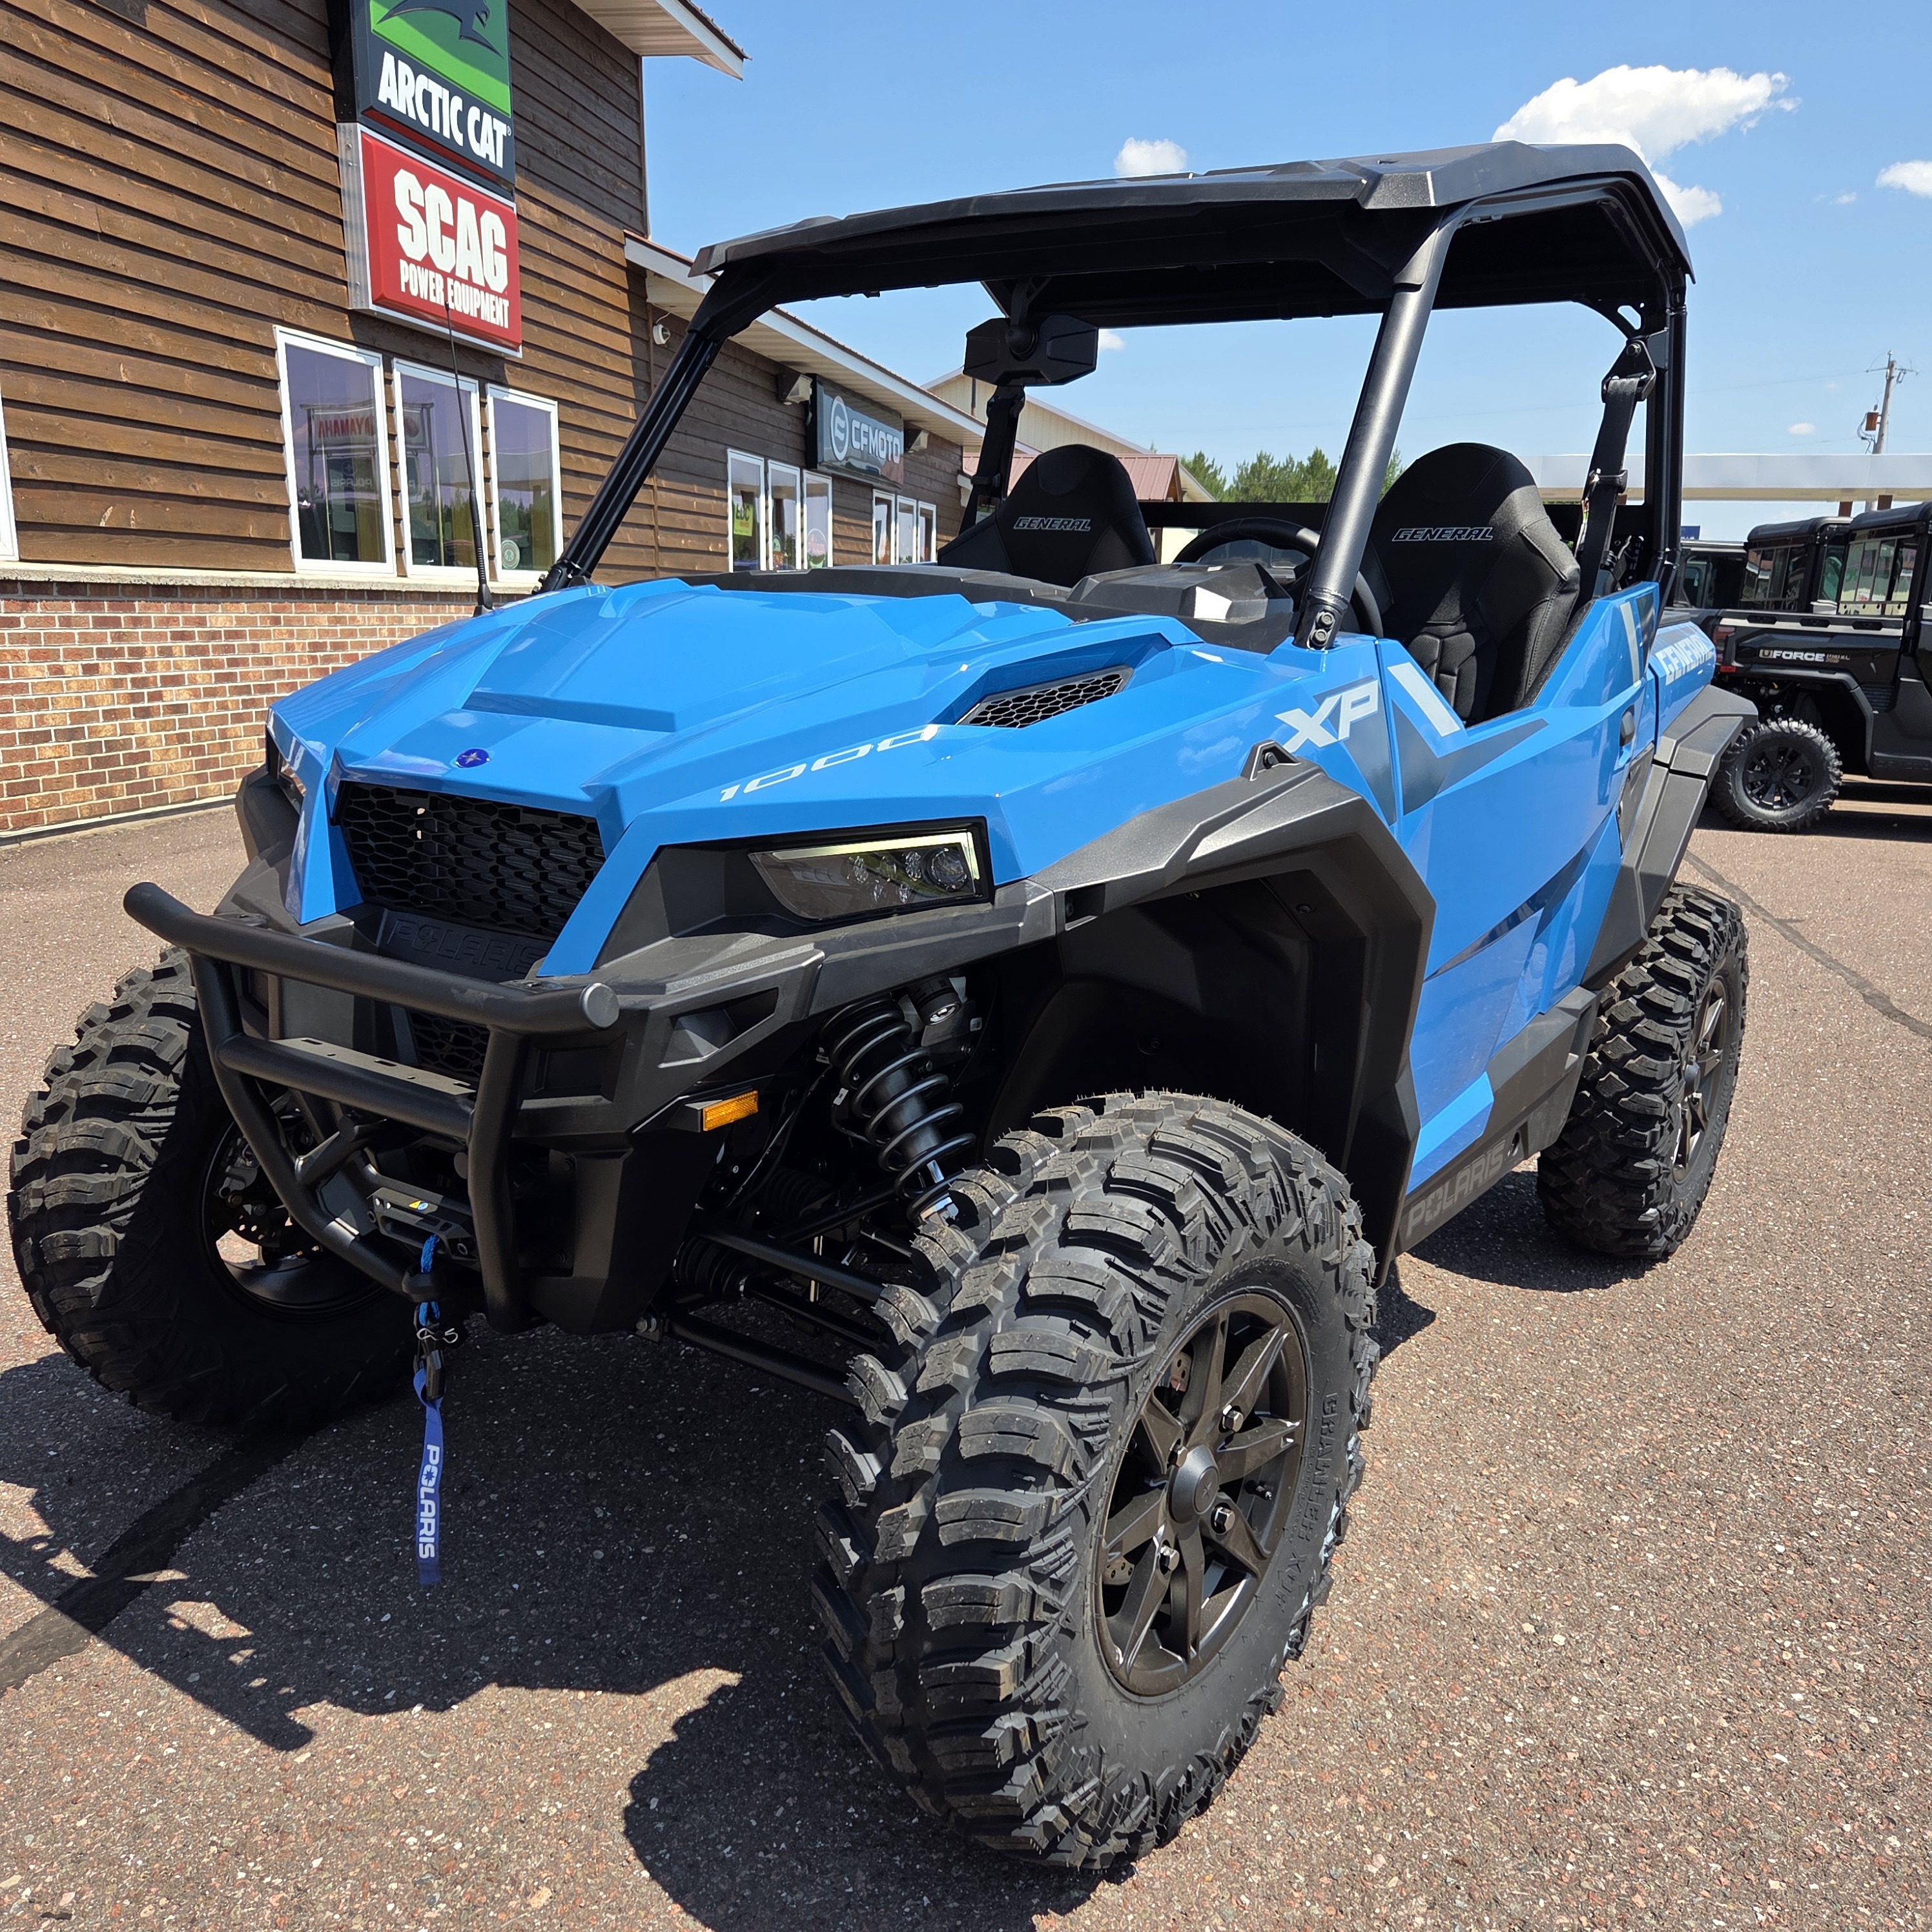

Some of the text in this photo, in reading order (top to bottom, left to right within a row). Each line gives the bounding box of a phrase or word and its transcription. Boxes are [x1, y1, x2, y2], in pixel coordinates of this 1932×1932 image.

[378, 51, 508, 169] ARCTIC CAT
[393, 169, 508, 294] SCAG
[399, 258, 509, 329] POWER EQUIPMENT
[851, 419, 901, 464] CFMOTO
[1013, 517, 1091, 531] GENERAL
[1392, 527, 1494, 542] GENERAL
[1274, 679, 1379, 754] XP
[719, 724, 938, 803] 1000
[387, 920, 551, 974] POLARIS
[1405, 1138, 1506, 1239] POLARIS
[419, 1444, 440, 1559] POLARIS
[1298, 1392, 1339, 1542] CRAWLER
